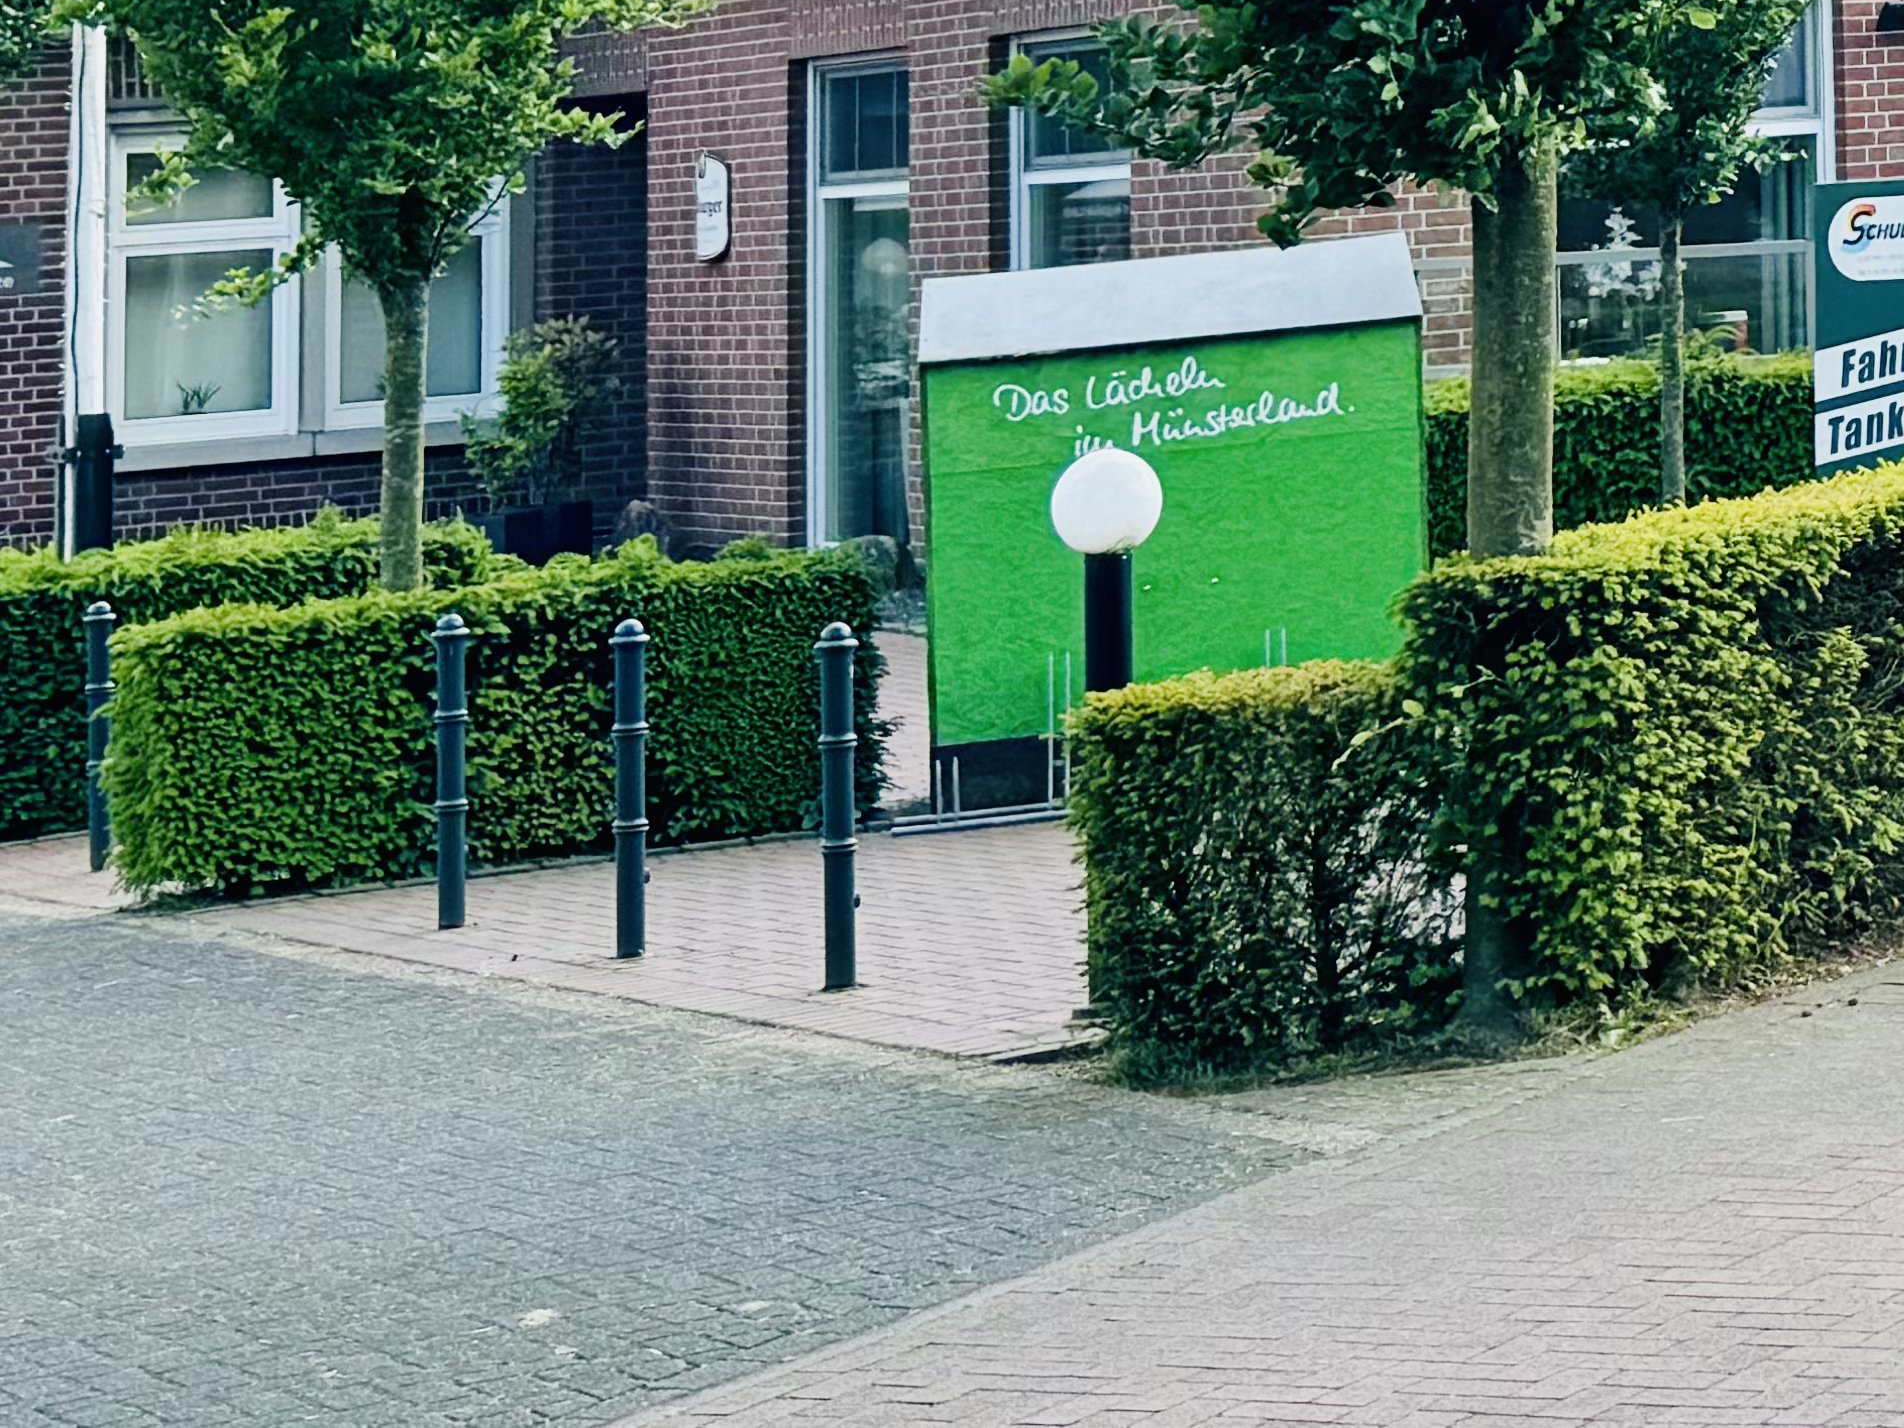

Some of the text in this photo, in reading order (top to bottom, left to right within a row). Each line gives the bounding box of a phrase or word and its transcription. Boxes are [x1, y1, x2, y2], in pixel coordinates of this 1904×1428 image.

[993, 355, 1226, 422] Das Lächeln
[1131, 381, 1355, 446] Münsterland.
